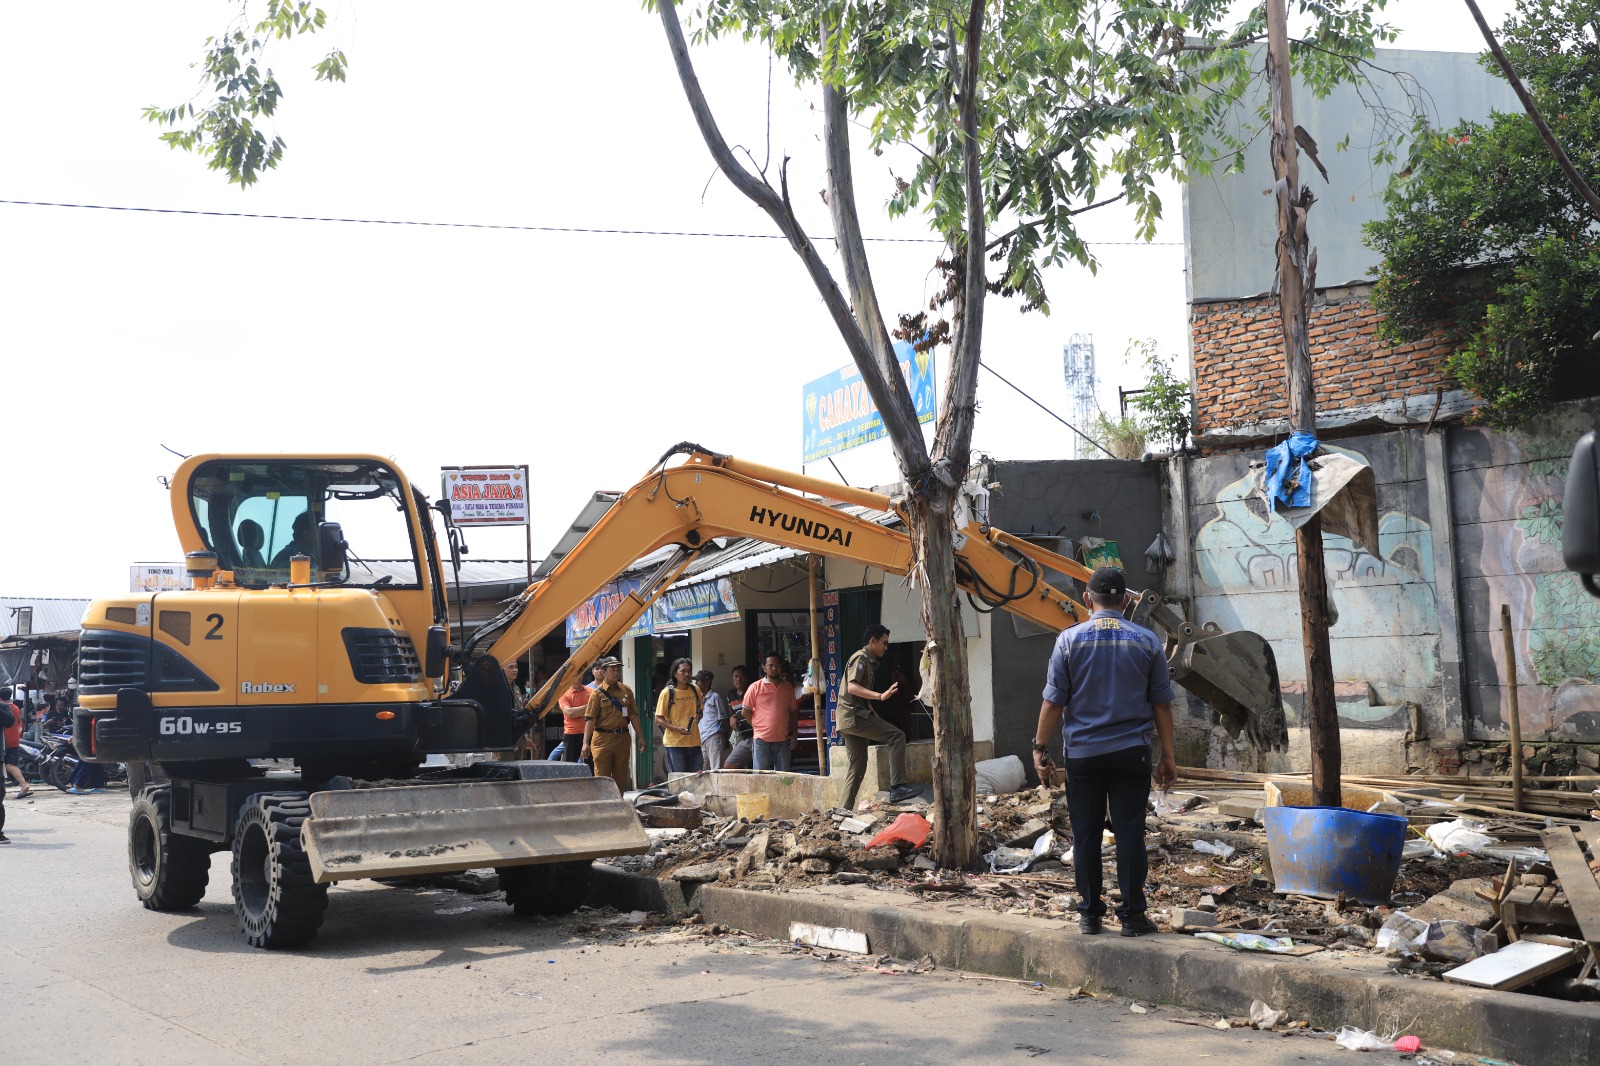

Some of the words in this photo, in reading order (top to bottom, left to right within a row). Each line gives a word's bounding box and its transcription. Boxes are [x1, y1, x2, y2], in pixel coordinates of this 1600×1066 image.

[819, 380, 870, 432] CAHAYA
[837, 429, 850, 441] BELI
[857, 418, 881, 433] TERIMA
[451, 484, 482, 501] ASIA
[483, 483, 514, 501] JAYA
[513, 486, 523, 501] 2
[489, 502, 505, 510] TERIMA
[505, 502, 524, 510] PESANAN
[749, 505, 853, 548] HYUNDAI
[667, 588, 696, 609] CAHAYA
[694, 582, 718, 604] BARU
[204, 613, 225, 640] 2
[1094, 618, 1120, 630] PUPR
[241, 681, 297, 694] Robex
